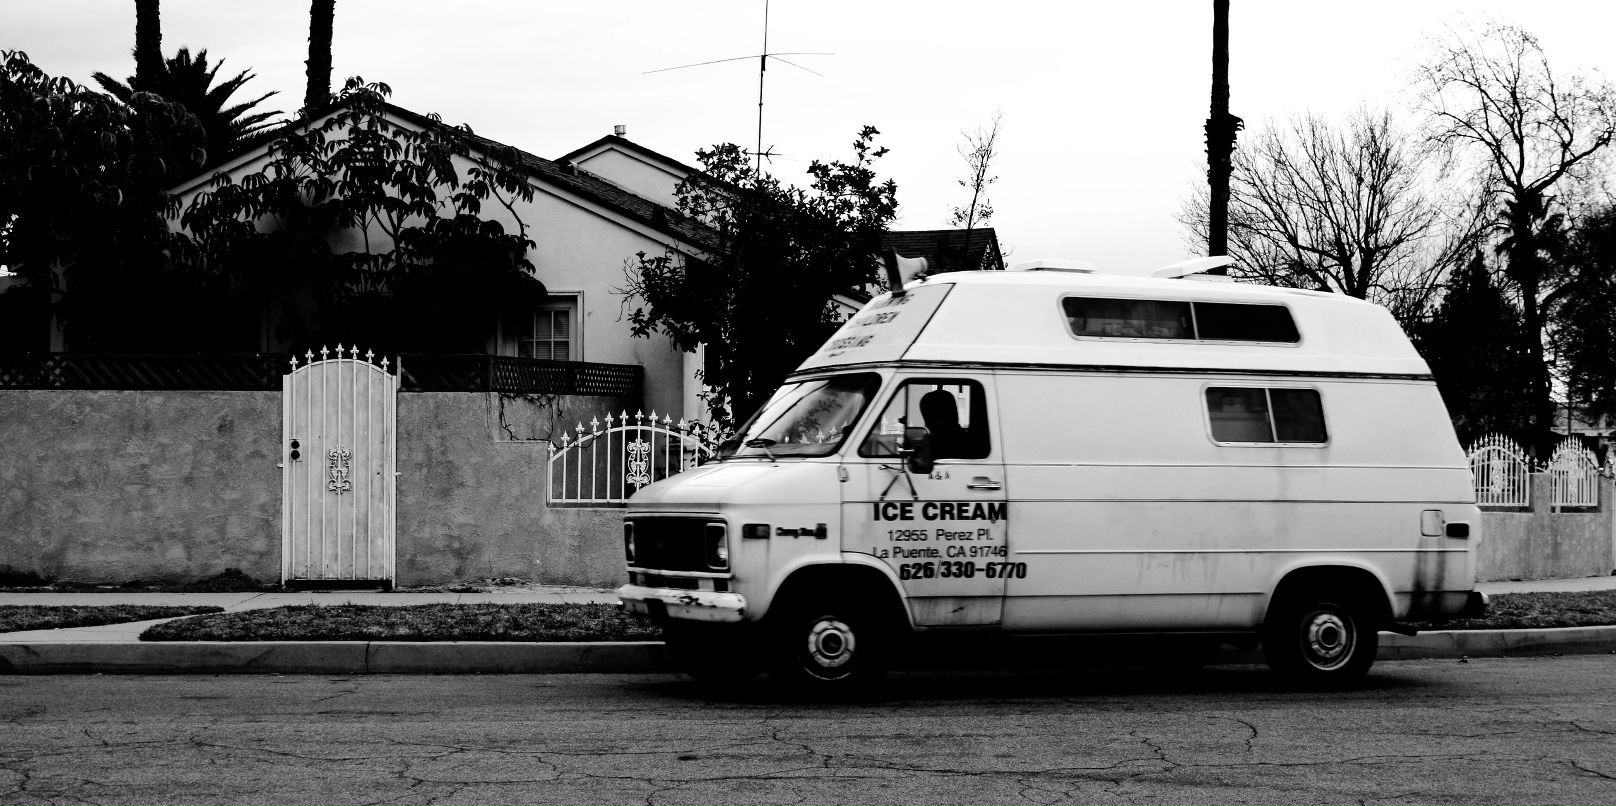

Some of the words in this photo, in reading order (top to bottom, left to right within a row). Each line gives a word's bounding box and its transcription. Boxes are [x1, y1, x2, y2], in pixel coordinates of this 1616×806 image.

[873, 502, 914, 521] ICE
[922, 502, 1007, 521] CREAM
[887, 529, 928, 541] 12955
[936, 528, 974, 541] Perez
[873, 546, 889, 558] La
[946, 545, 966, 557] CA
[969, 545, 1008, 557] 91746
[900, 560, 1027, 580] 626/330-6770
